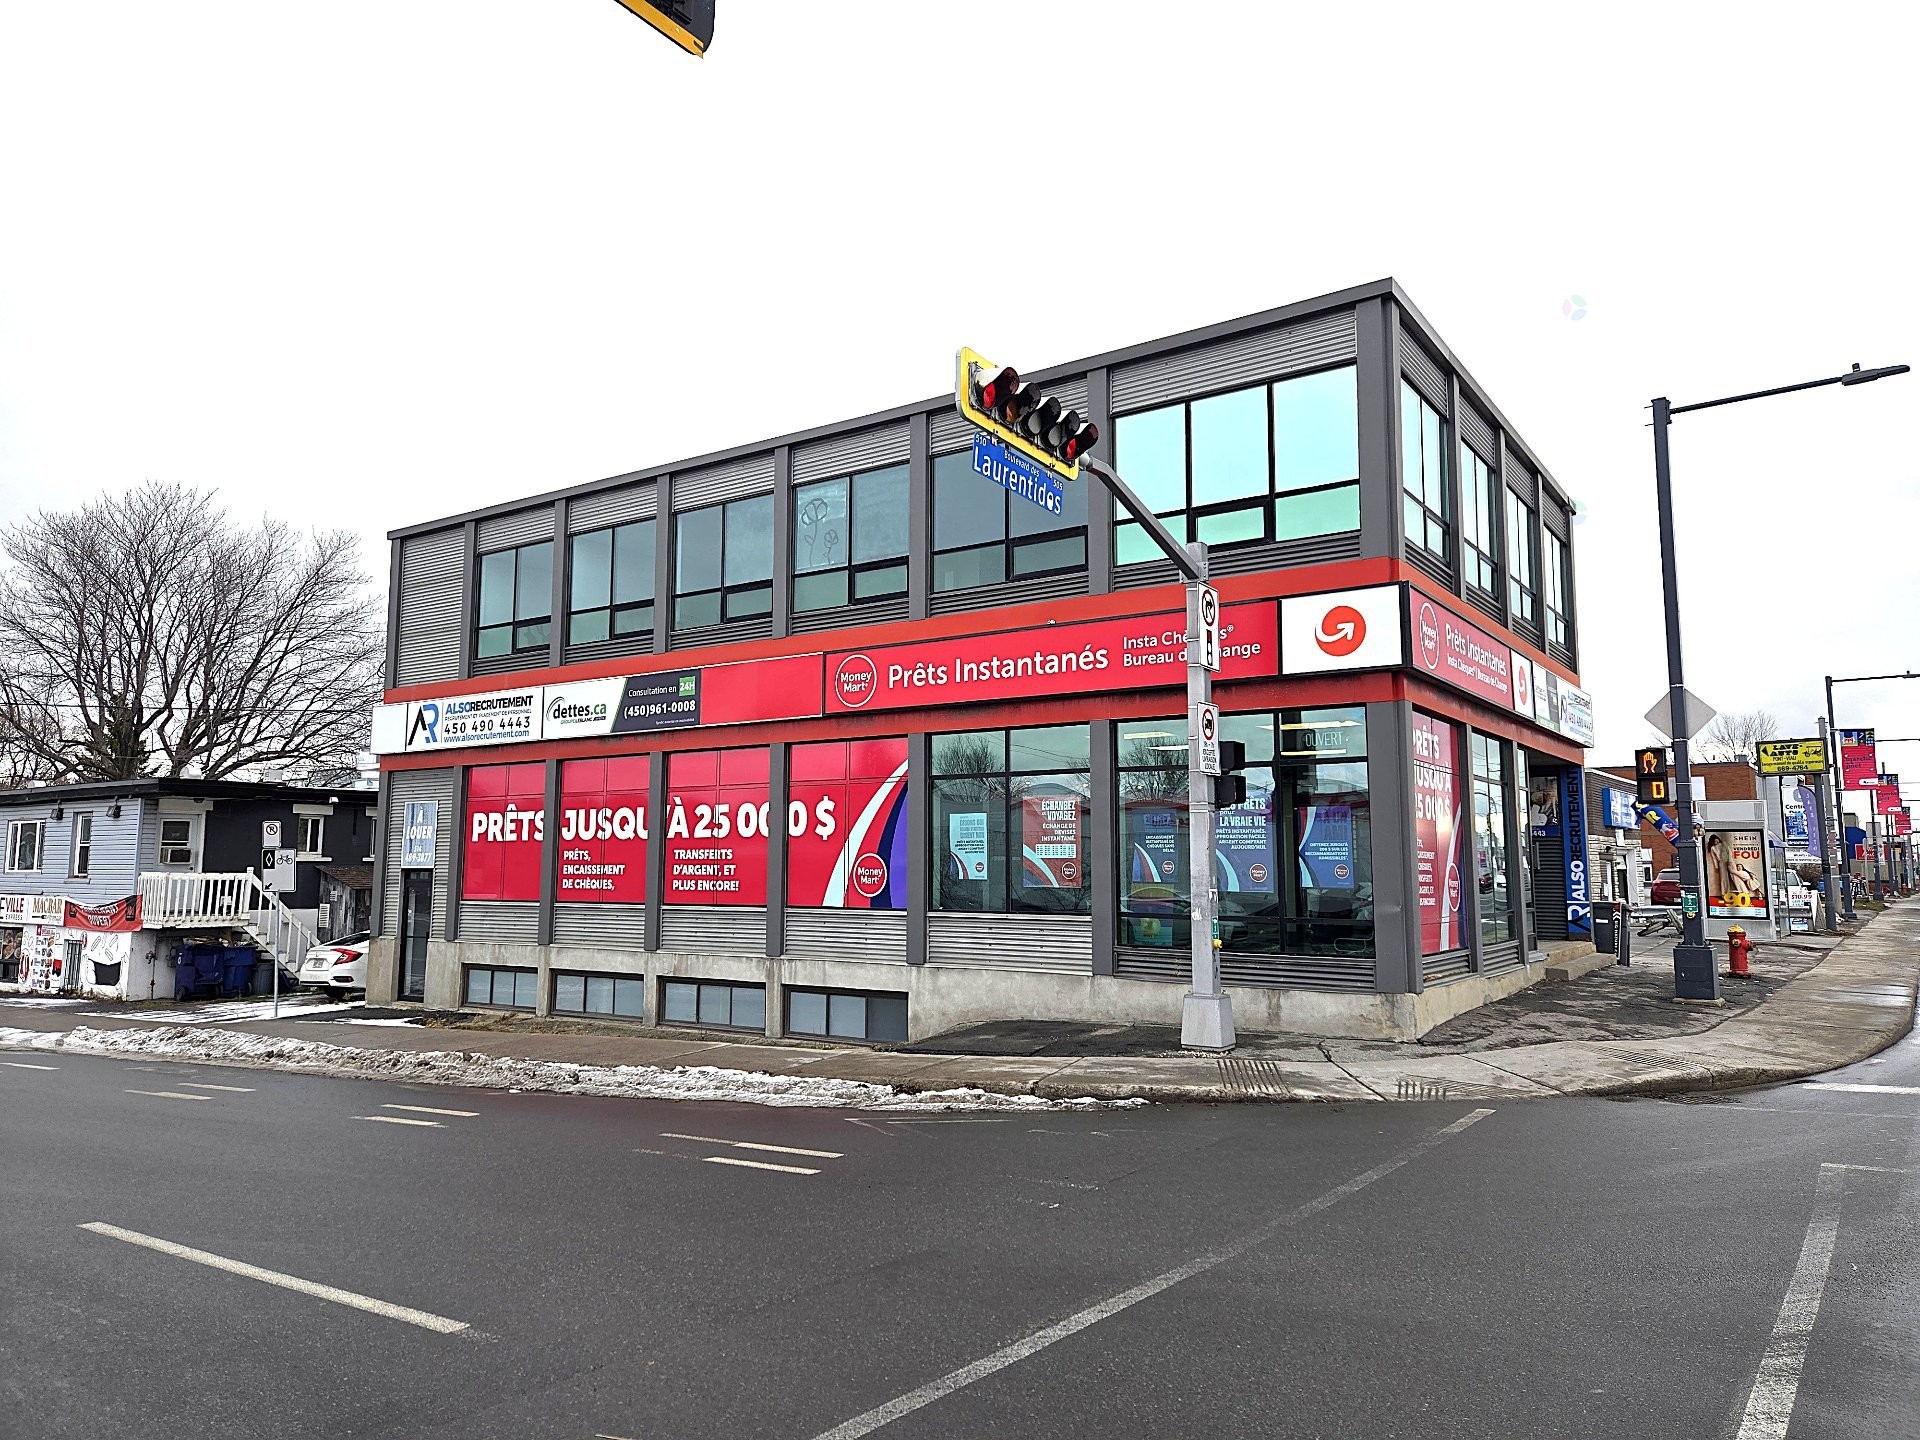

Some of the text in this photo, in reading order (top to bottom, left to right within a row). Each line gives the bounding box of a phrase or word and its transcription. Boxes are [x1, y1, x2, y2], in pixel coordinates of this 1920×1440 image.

[976, 434, 986, 446] 510
[1030, 466, 1039, 477] des
[1422, 620, 1437, 642] Money
[1123, 633, 1158, 650] Insta
[1445, 622, 1507, 677] Prêts Instantanés
[888, 643, 1109, 689] Prêts Instantanés
[1123, 652, 1174, 667] Bureau
[840, 671, 872, 683] Money
[628, 680, 696, 697] Consultation en 24H
[445, 695, 534, 715] ALSORECRUTEMENT
[552, 703, 607, 720] dettes.ca
[623, 699, 696, 719] (450)961-0008
[444, 716, 531, 735] 450 490 4443
[444, 729, 530, 743] www.alsorecrutement.com
[1305, 731, 1343, 747] OUVERT
[472, 803, 544, 842] PRÊTS
[693, 804, 731, 838] 25
[814, 795, 836, 840] $
[1047, 810, 1077, 821] VOYAGEZ
[1220, 816, 1267, 827] LA VRAIE VIE
[405, 825, 433, 840] LOUER
[1566, 765, 1586, 902] ALSORECRUTEMENT
[563, 848, 591, 860] PRÊTS,
[673, 849, 733, 860] TRANSFERTS
[1733, 851, 1760, 860] FOU
[562, 864, 625, 875] ENCAISSEMENT
[673, 864, 736, 876] D'ARGENT, ET
[857, 866, 883, 878] Money
[562, 877, 615, 891] DE CHÈQUES,
[672, 880, 739, 892] PLUS ENCORE!
